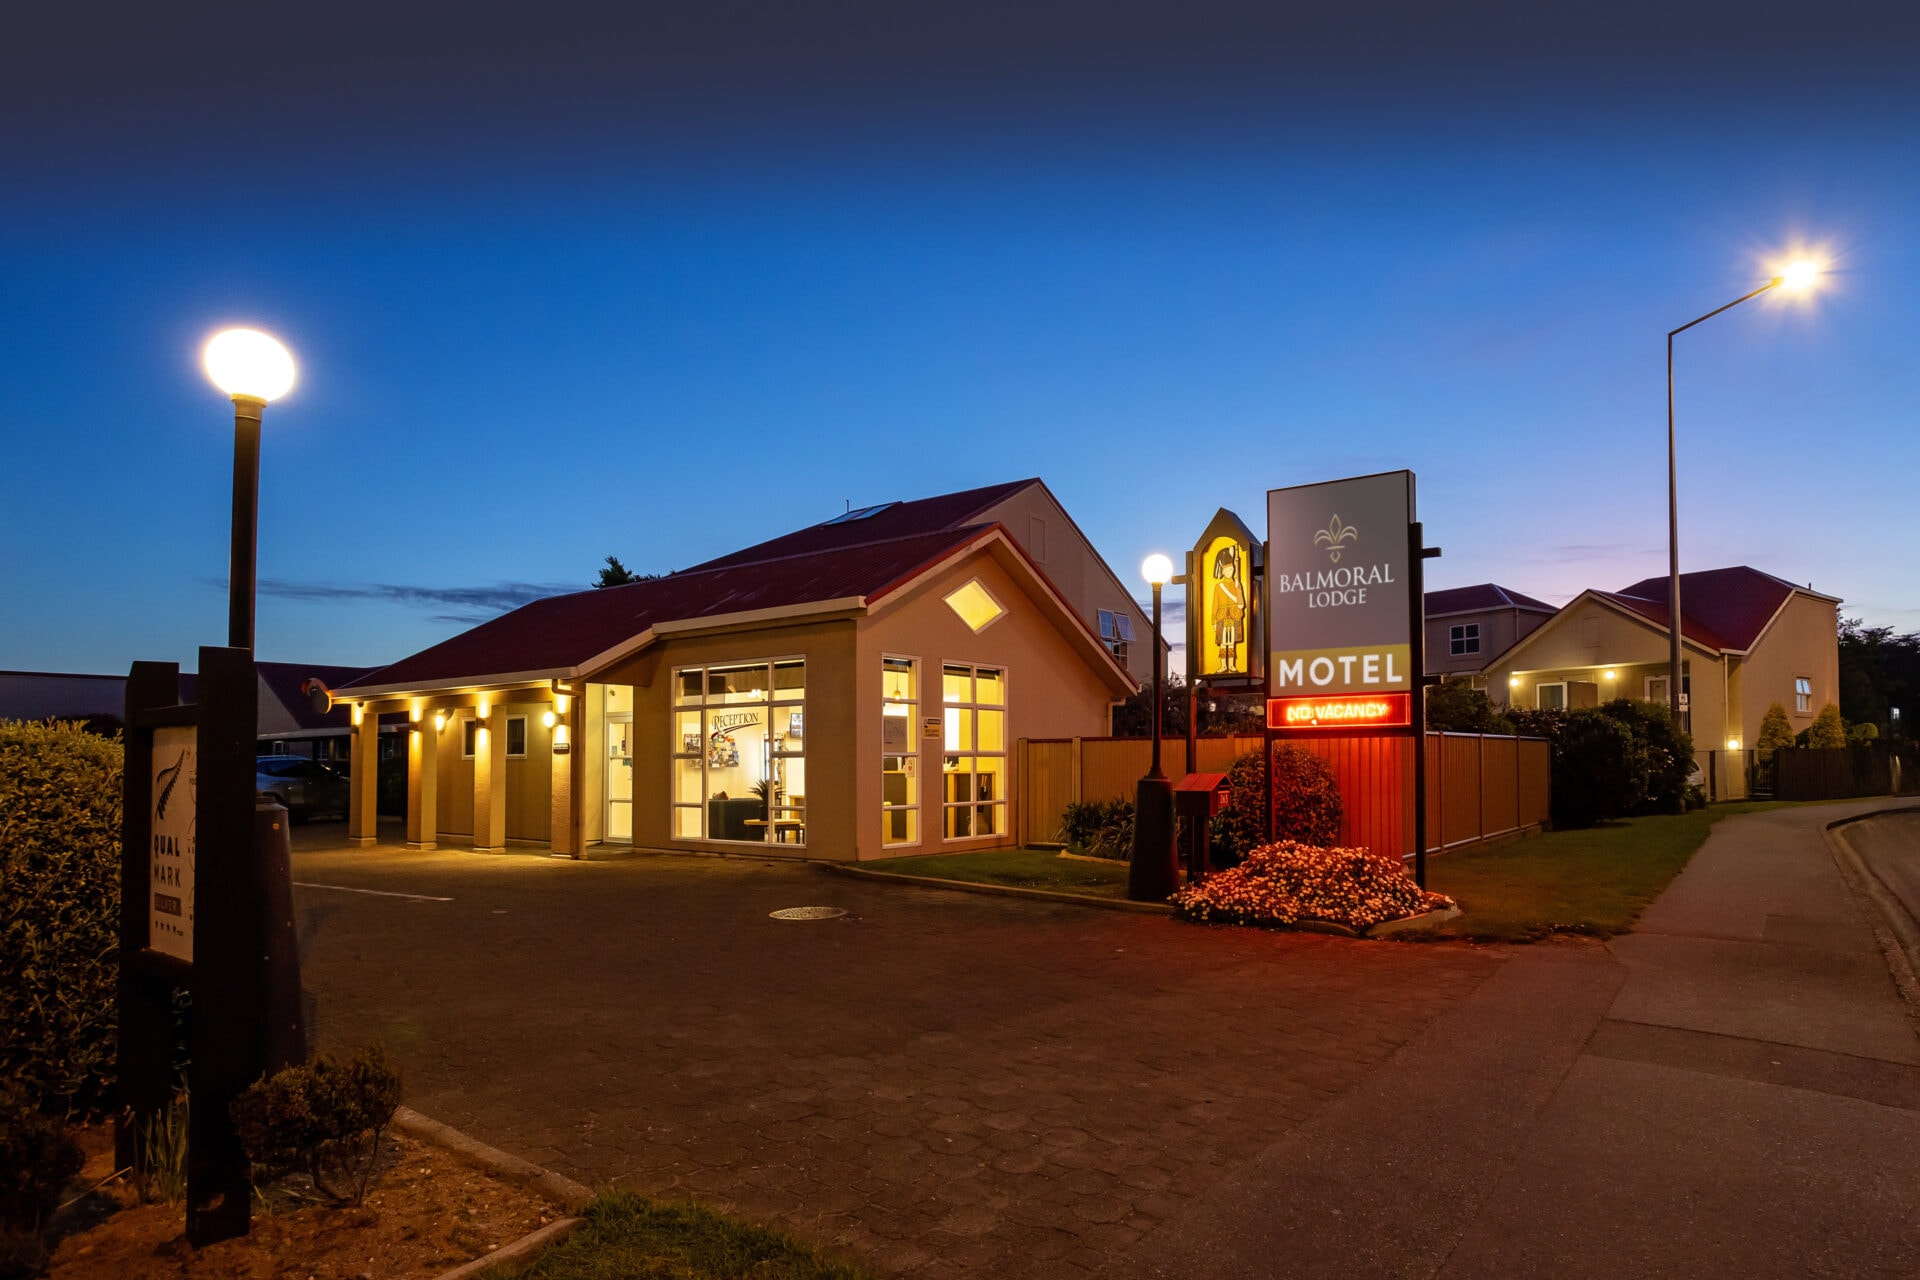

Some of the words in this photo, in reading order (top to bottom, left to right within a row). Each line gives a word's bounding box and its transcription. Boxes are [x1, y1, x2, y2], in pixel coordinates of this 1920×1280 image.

[1280, 563, 1395, 593] BALMORAL
[1308, 588, 1367, 609] LODGE
[1279, 653, 1403, 687] MOTEL
[712, 712, 760, 731] RECEPTION
[1287, 705, 1311, 721] NO
[1315, 703, 1387, 719] VACANCY
[154, 834, 180, 859] QUAL
[154, 864, 181, 888] MARK
